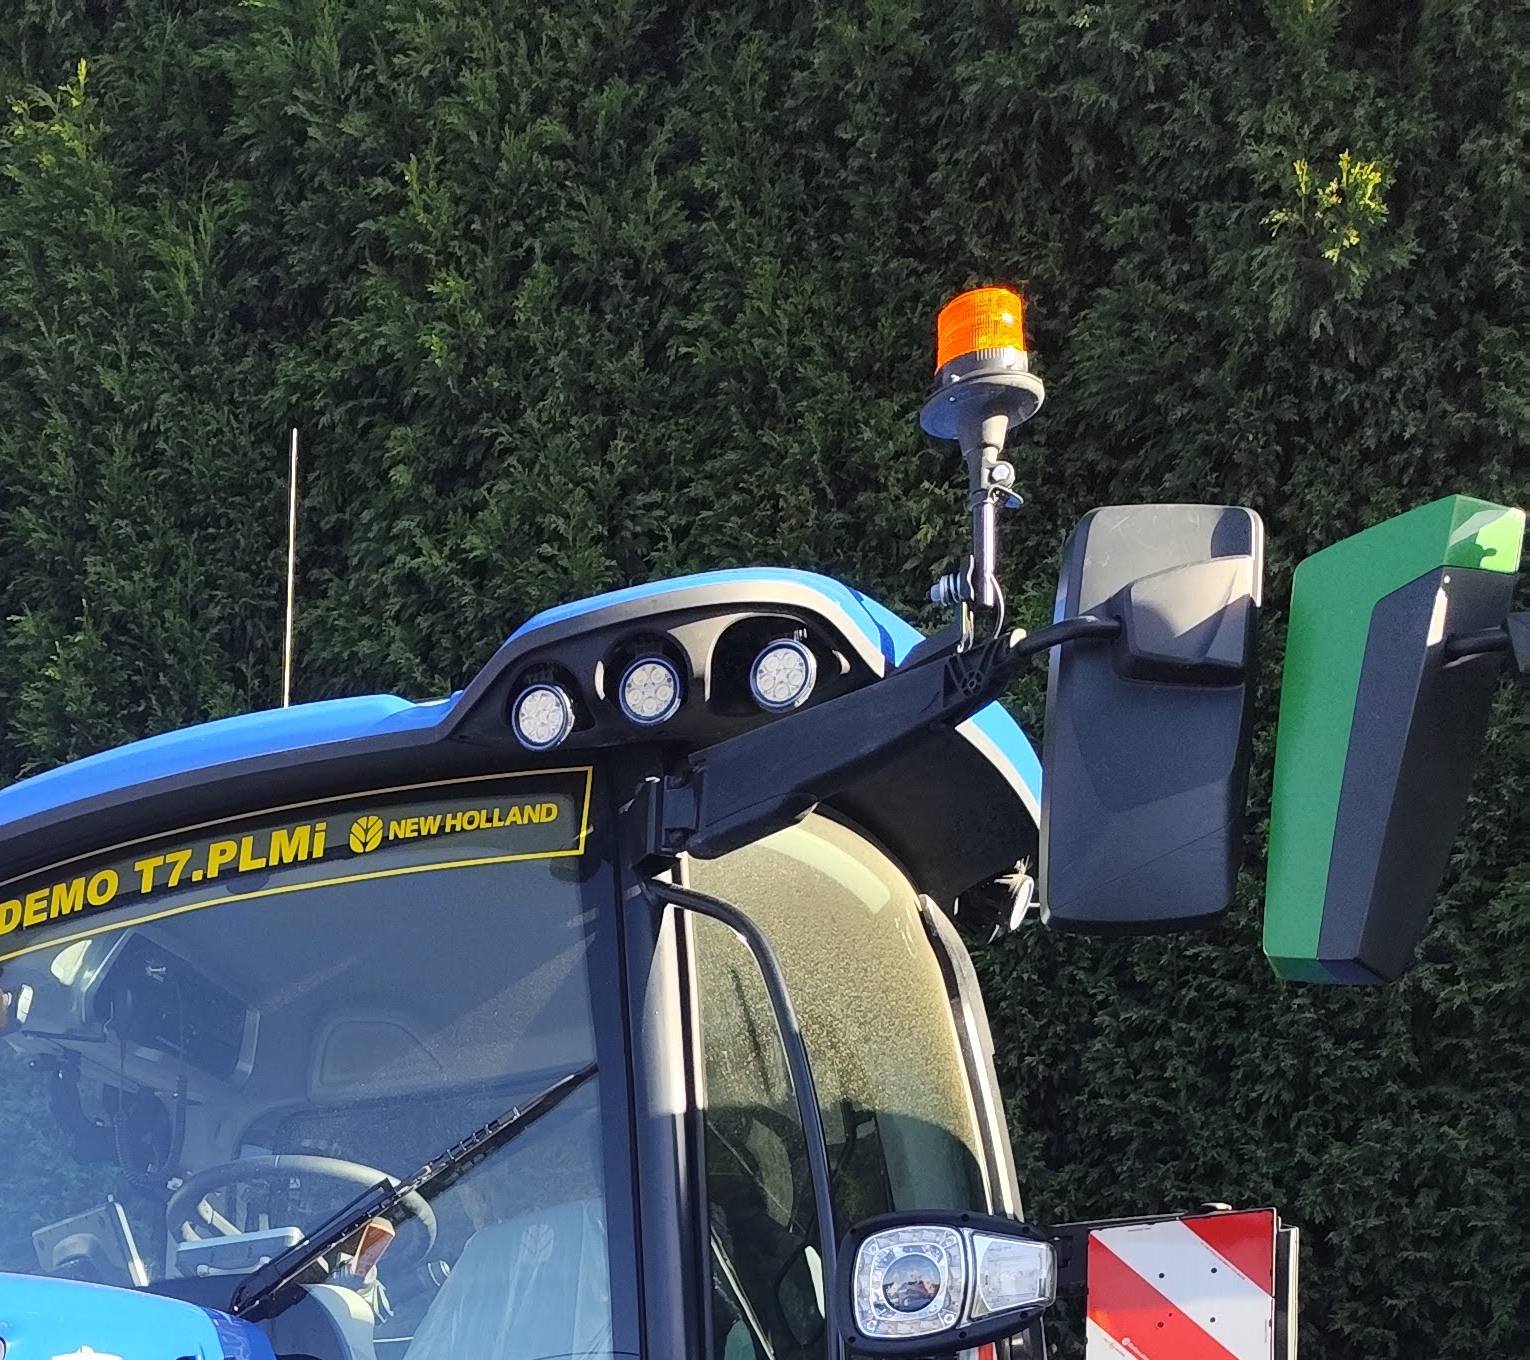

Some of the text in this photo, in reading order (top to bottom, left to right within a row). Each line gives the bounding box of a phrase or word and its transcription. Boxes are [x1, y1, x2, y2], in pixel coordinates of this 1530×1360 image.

[388, 802, 559, 841] NEW HOLLAND
[134, 822, 327, 894] T7.PLMi
